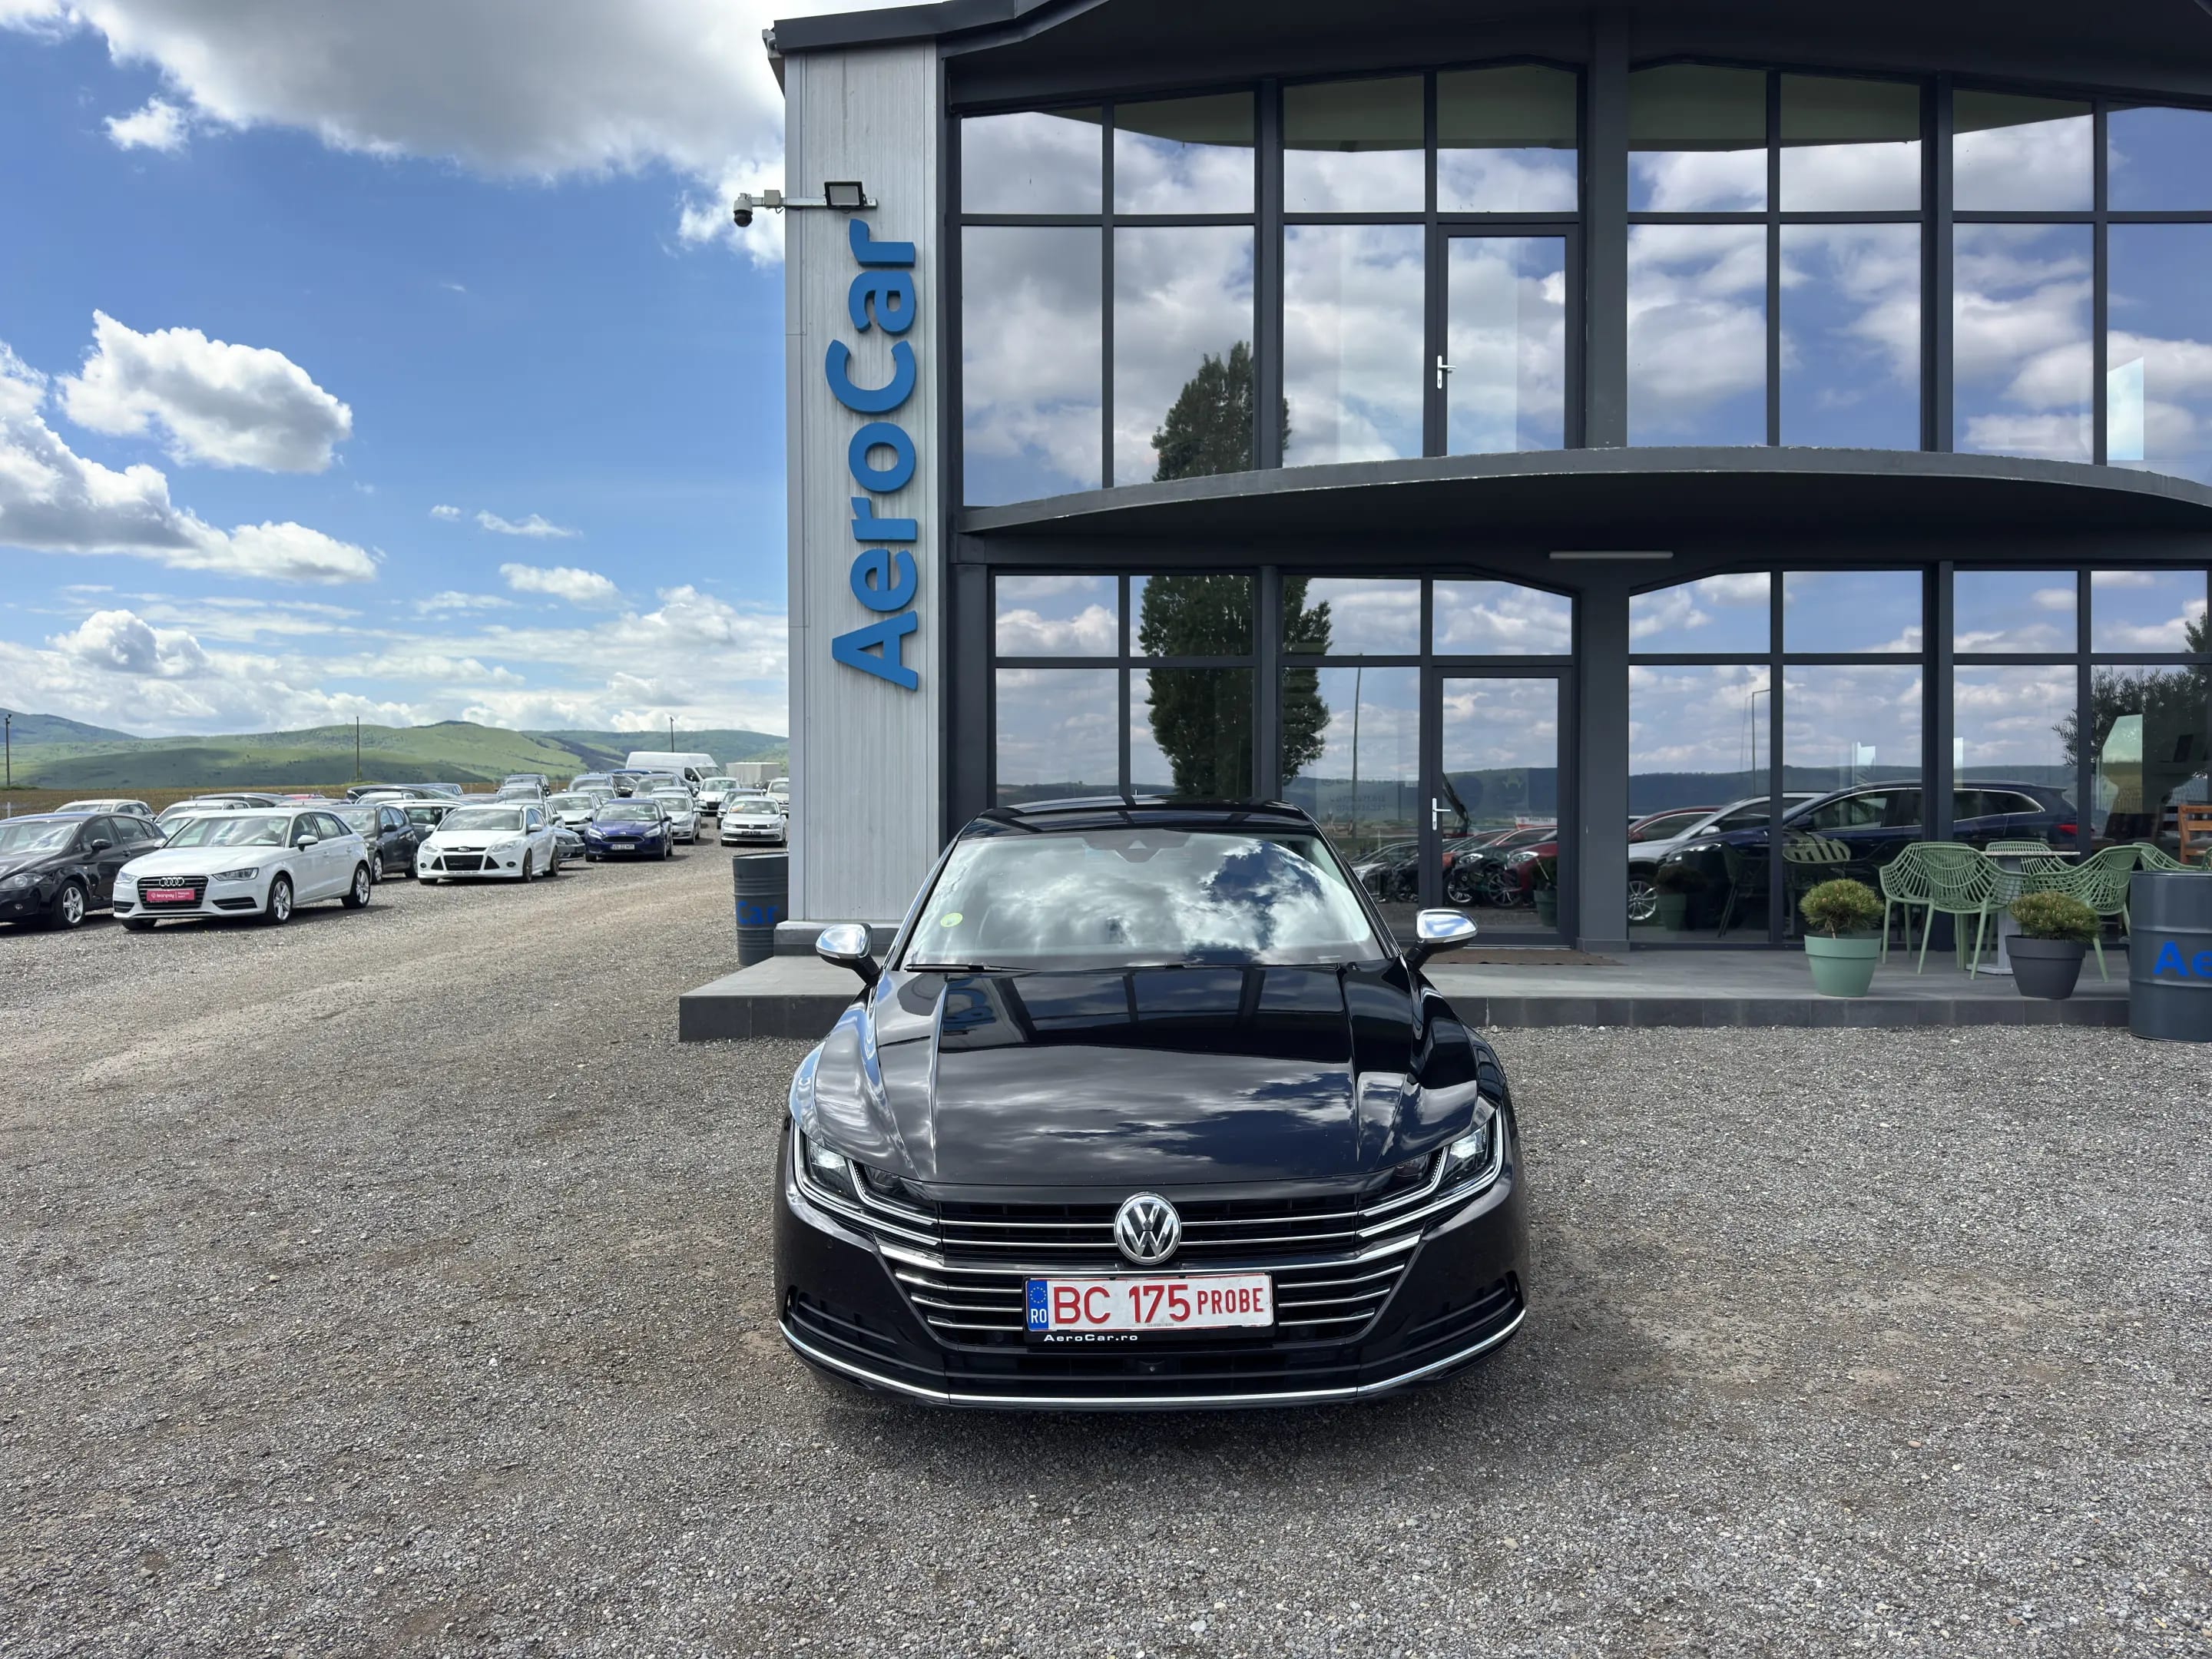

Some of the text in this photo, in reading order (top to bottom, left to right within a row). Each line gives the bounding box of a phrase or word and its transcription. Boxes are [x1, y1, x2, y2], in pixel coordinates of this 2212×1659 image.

[824, 217, 919, 691] AeroCar
[1031, 1309, 1047, 1324] RO
[1053, 1284, 1264, 1324] BC 175 PROBE
